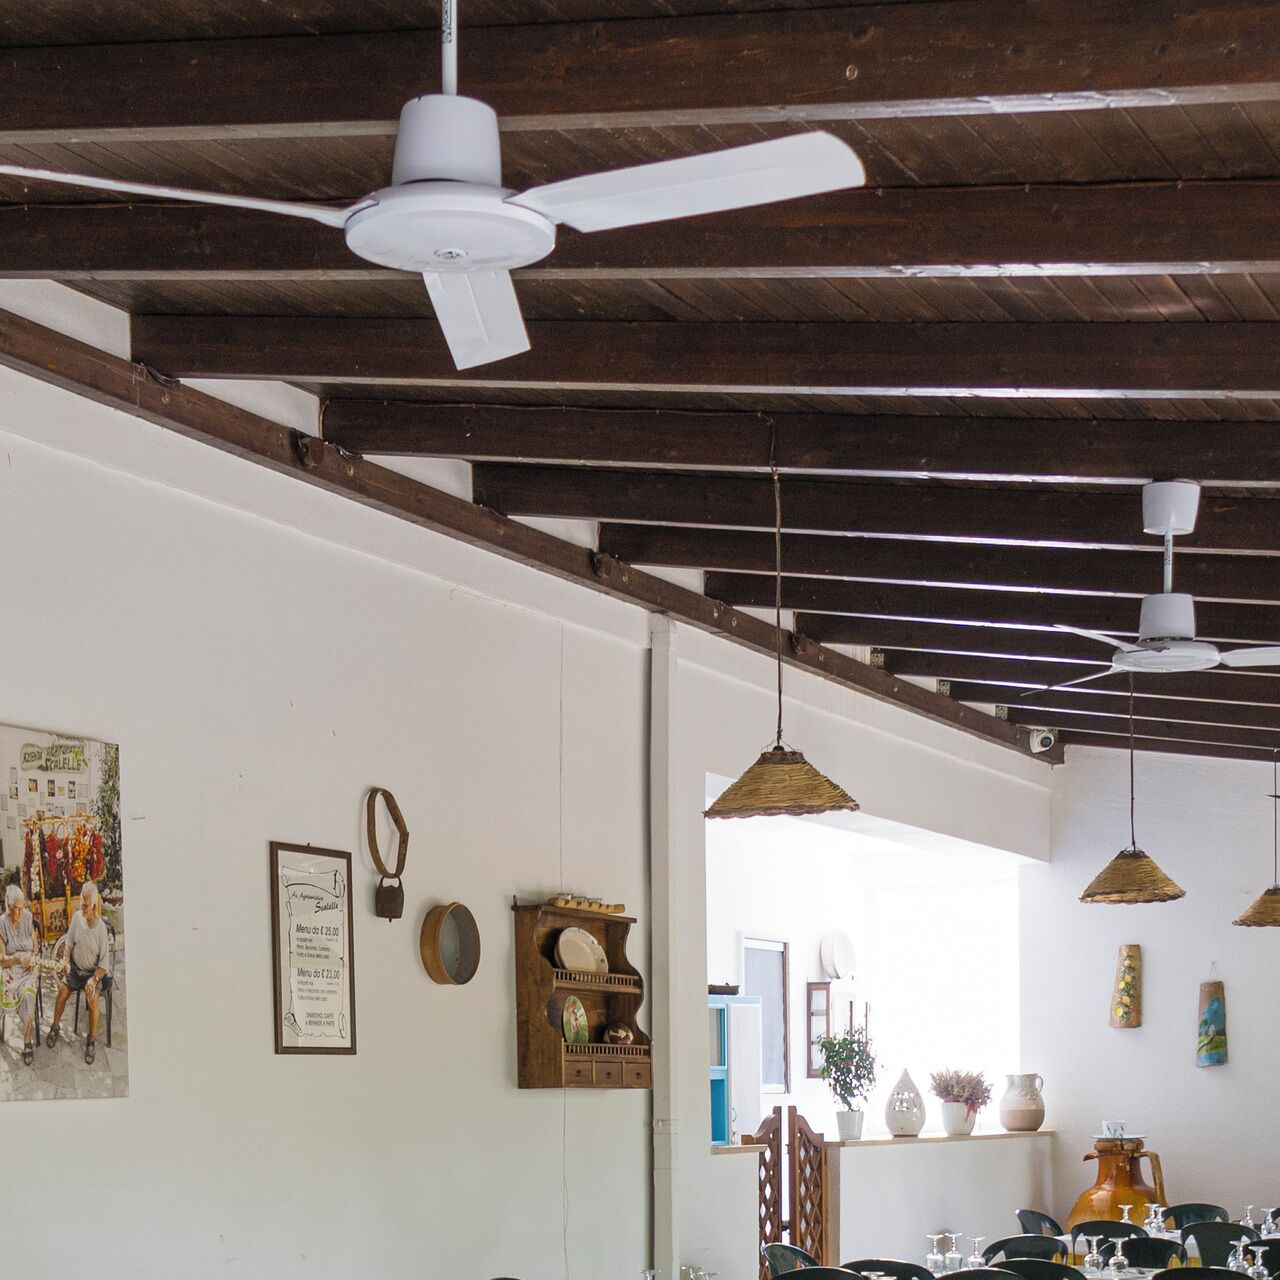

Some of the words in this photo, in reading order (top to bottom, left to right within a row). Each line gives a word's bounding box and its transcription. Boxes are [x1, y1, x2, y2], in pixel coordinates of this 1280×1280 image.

[296, 923, 311, 934] Menu
[325, 926, 339, 937] 25,00
[297, 967, 312, 977] Menu
[326, 969, 340, 980] 23,00
